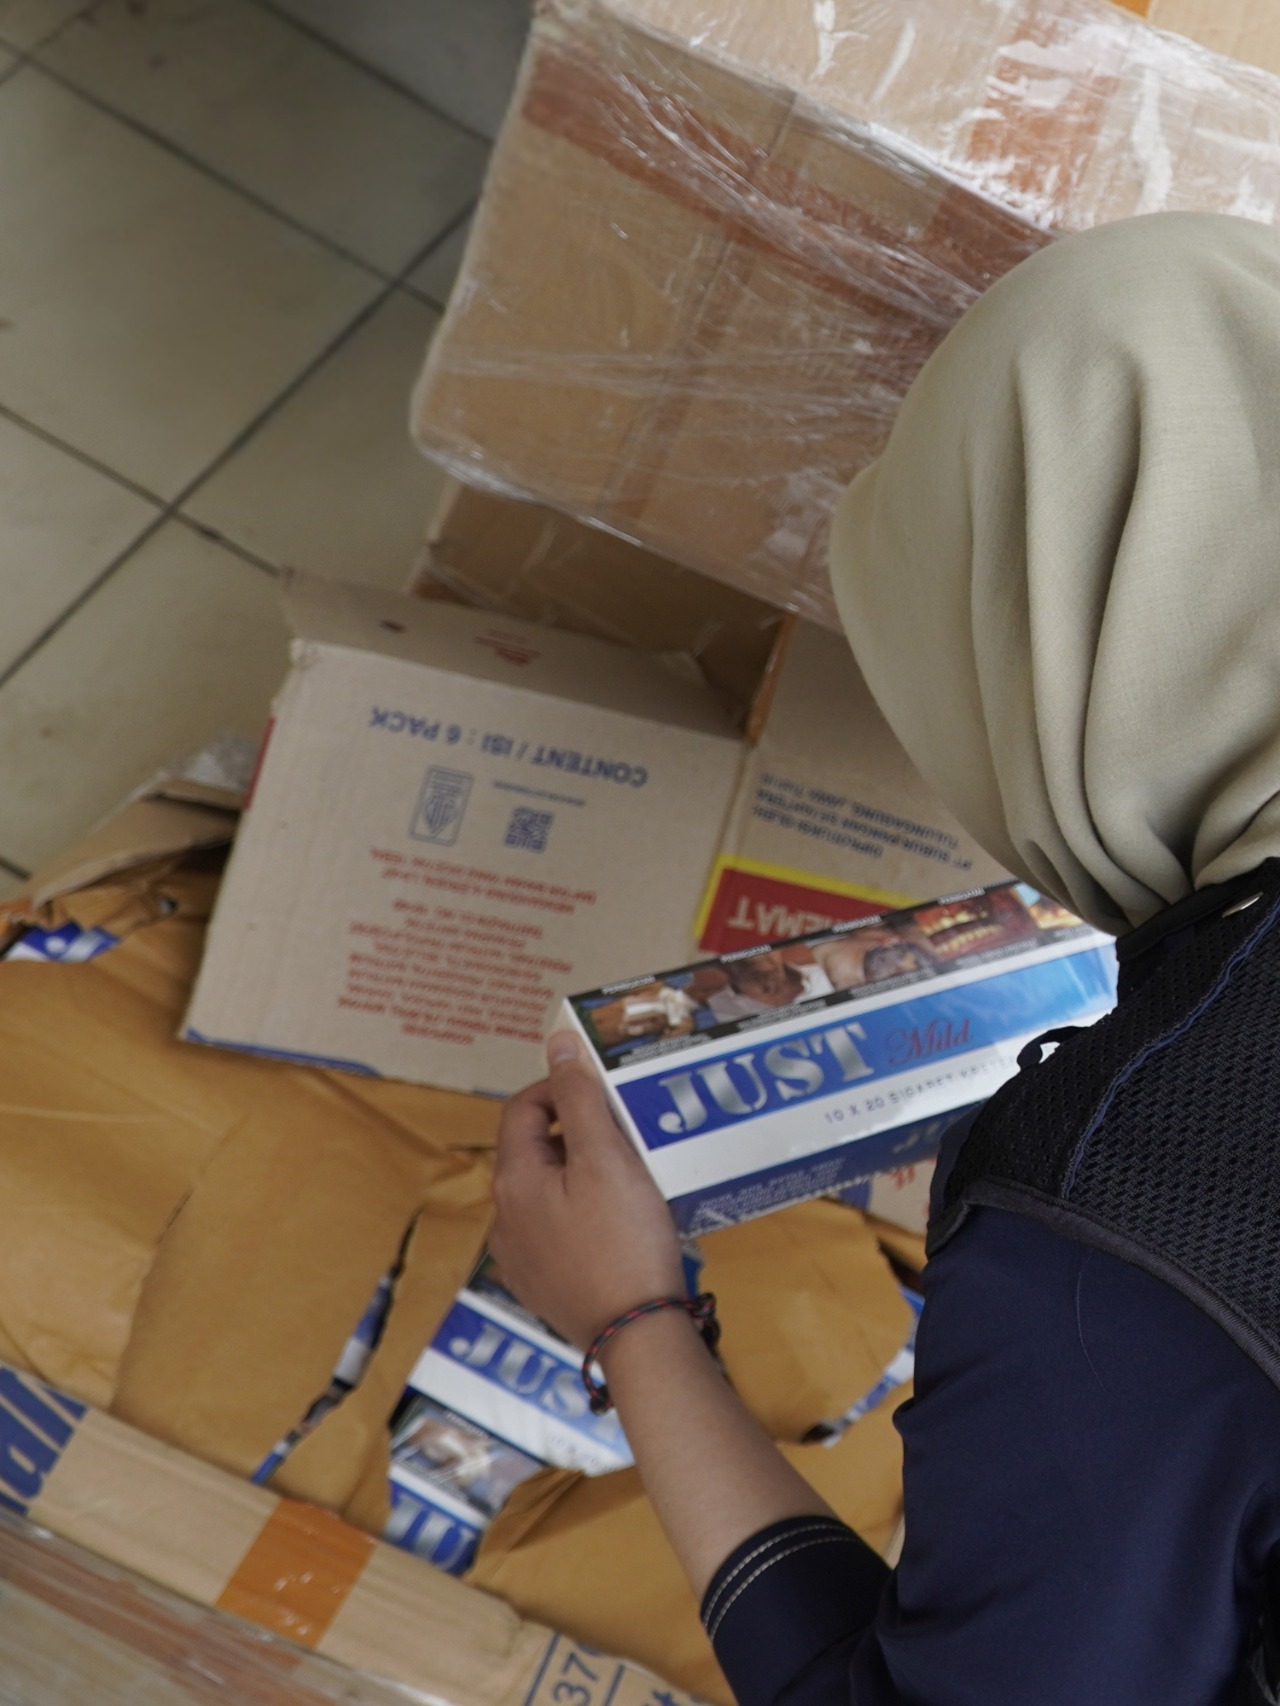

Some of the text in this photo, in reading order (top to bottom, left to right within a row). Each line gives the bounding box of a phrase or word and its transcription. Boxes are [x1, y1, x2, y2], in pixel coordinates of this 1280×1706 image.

[369, 706, 441, 742] PACK
[446, 723, 462, 746] 6
[480, 732, 515, 757] ISI
[531, 742, 649, 788] CONTENT
[727, 894, 837, 939] EMAT
[657, 1021, 875, 1135] JUST
[884, 1017, 972, 1068] Mild
[824, 1109, 846, 1125] 10
[864, 1096, 887, 1114] 20
